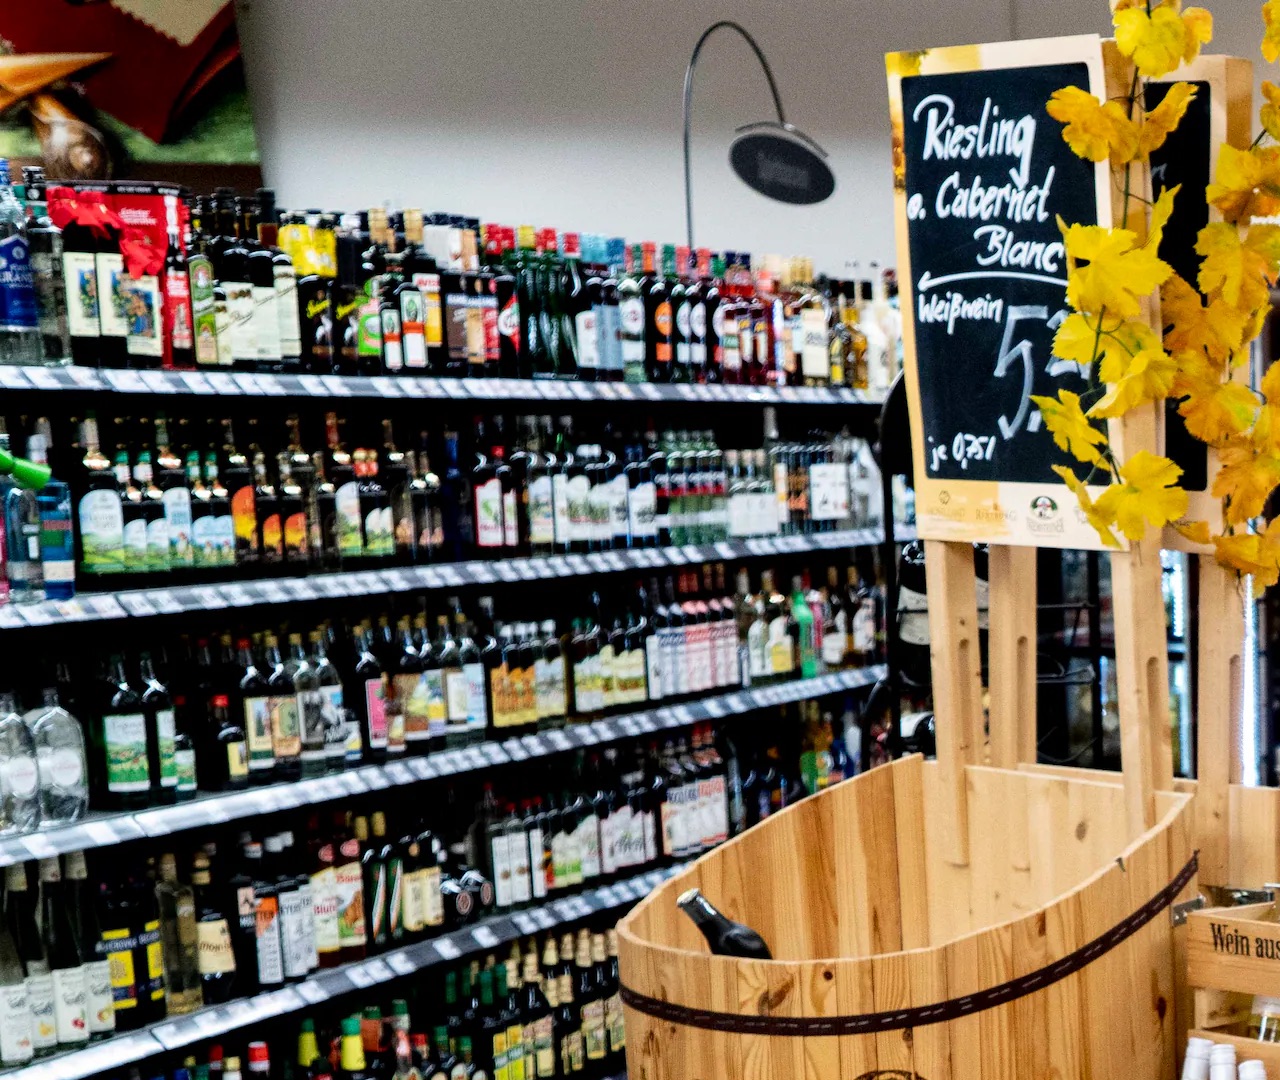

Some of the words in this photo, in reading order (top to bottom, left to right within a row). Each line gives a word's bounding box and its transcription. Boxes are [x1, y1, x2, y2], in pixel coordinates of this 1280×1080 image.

[913, 94, 1036, 189] Riesling
[936, 165, 1056, 224] Cabernet
[974, 224, 1065, 273] Blanc
[918, 292, 1003, 335] Weißwein
[1210, 923, 1250, 957] Wein
